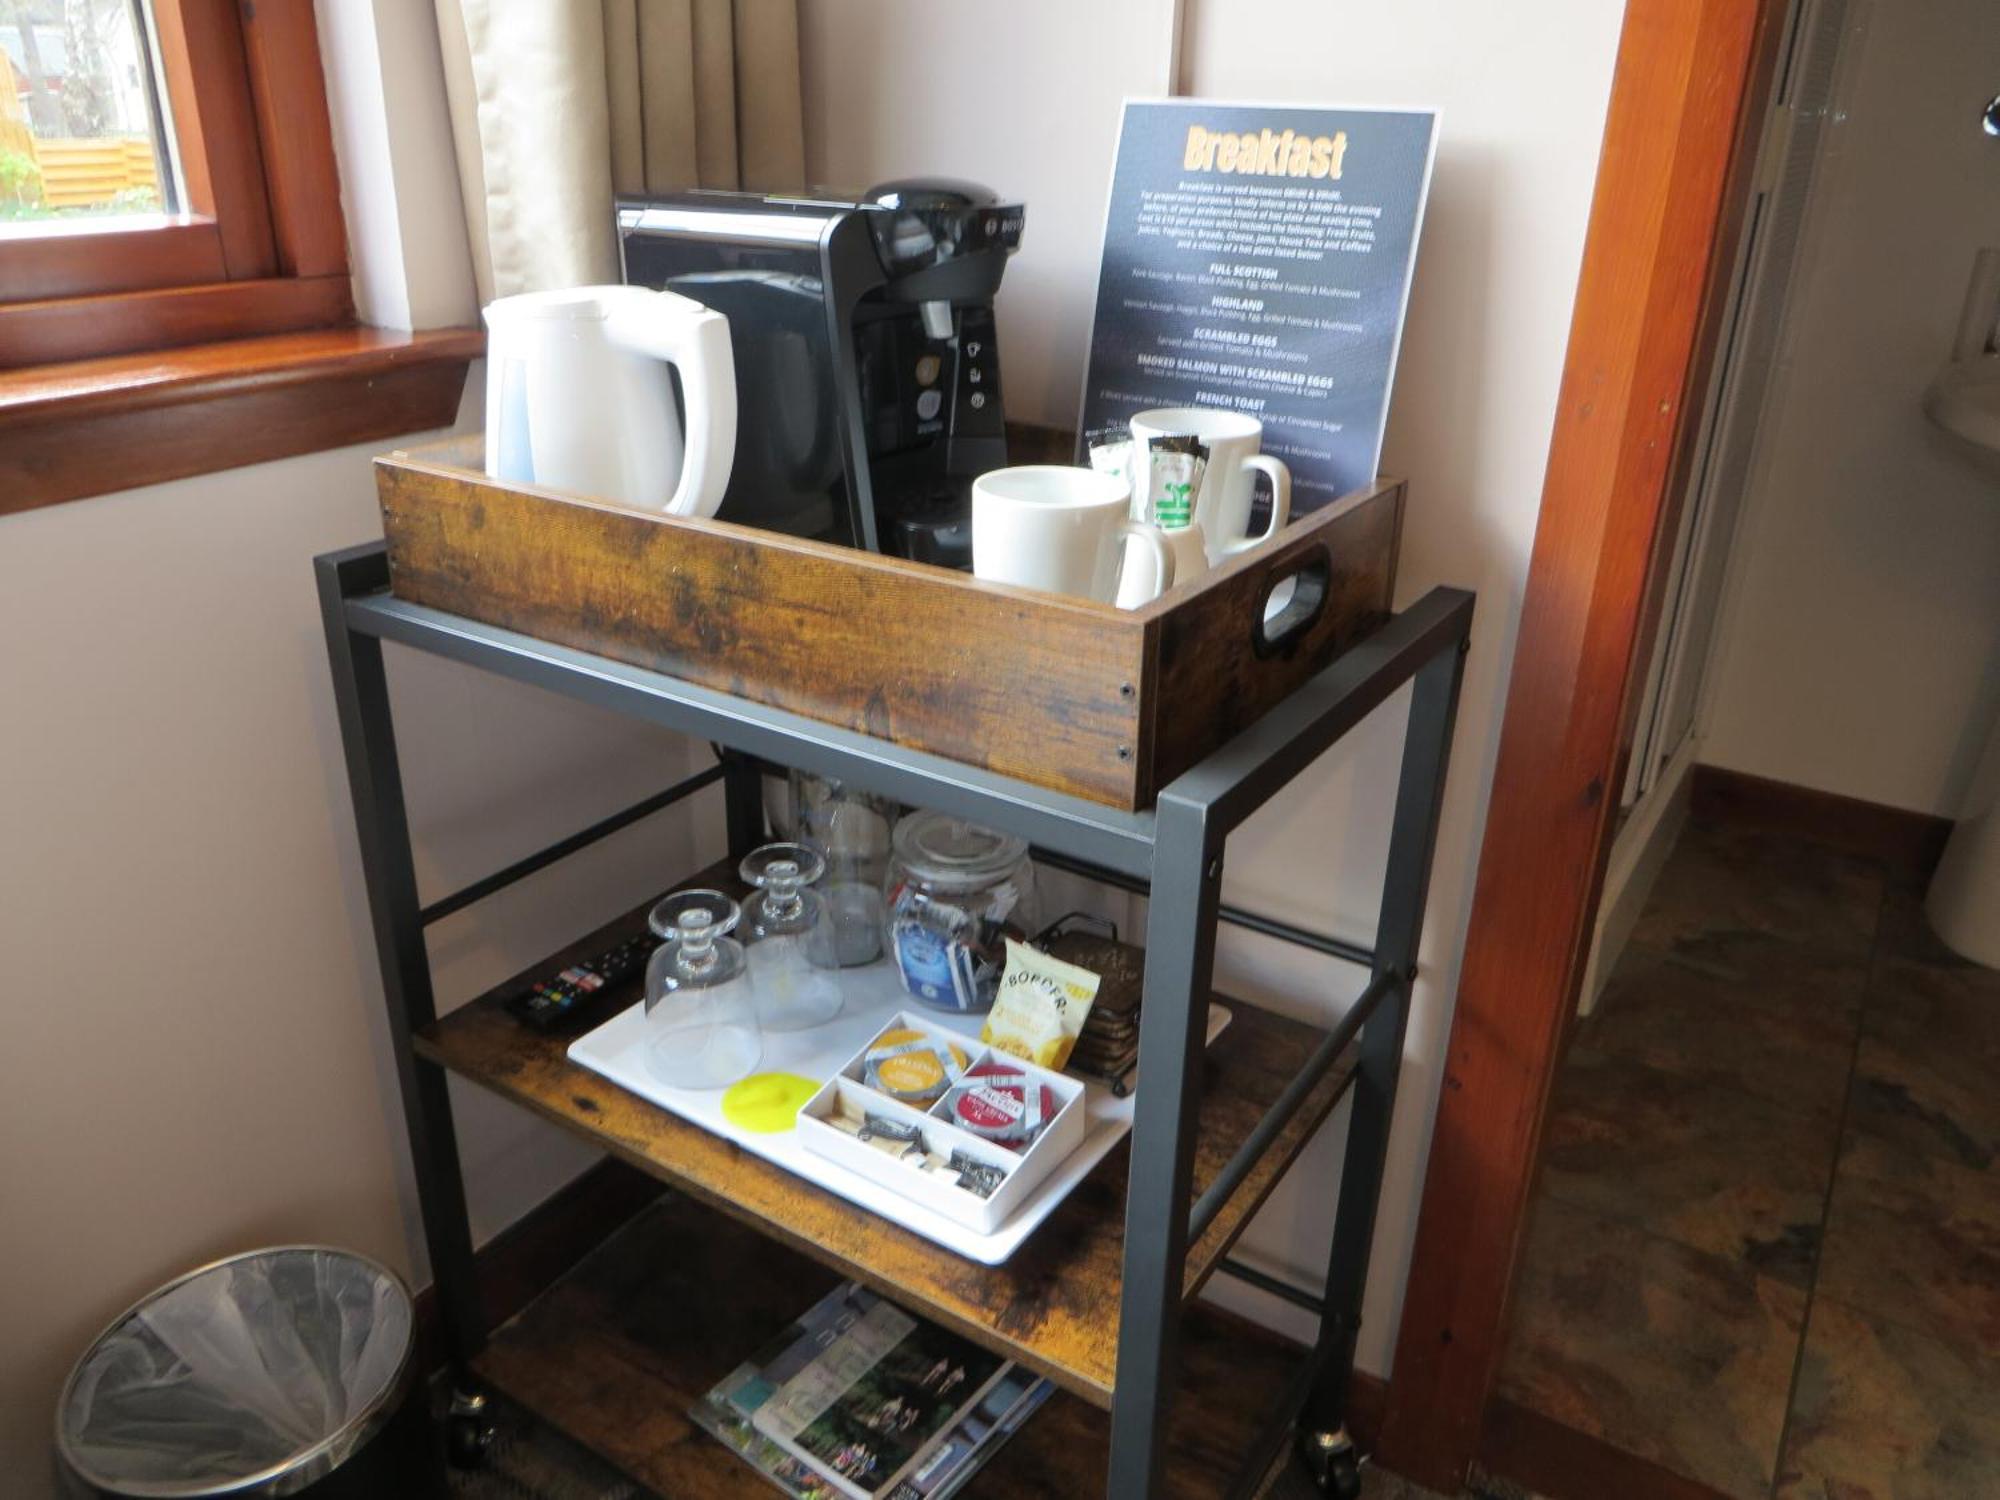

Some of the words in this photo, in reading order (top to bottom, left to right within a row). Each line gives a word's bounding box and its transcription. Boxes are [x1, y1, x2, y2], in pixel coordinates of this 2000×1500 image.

[1184, 125, 1347, 180] Breakfast
[1178, 205, 1196, 215] your
[1196, 206, 1232, 218] preferred
[1233, 208, 1257, 219] choice
[1267, 211, 1282, 221] hot
[1282, 212, 1303, 223] plate
[1304, 213, 1320, 224] and
[1320, 214, 1350, 226] seating
[1234, 197, 1258, 208] kindly
[1259, 199, 1285, 210] inform
[1297, 201, 1308, 211] by
[1333, 204, 1347, 214] the
[1348, 205, 1381, 216] evening
[1188, 217, 1214, 228] person
[1215, 219, 1238, 230] which
[1239, 220, 1270, 232] includes
[1272, 222, 1285, 233] the
[1326, 226, 1349, 237] Fresh
[1176, 238, 1191, 250] and
[1198, 240, 1222, 252] choice
[1238, 243, 1252, 254] hot
[1252, 244, 1273, 256] plate
[1274, 245, 1296, 257] listed
[1278, 234, 1303, 246] House
[1304, 235, 1323, 247] Teas
[1323, 237, 1340, 248] and
[1340, 238, 1372, 250] Coffees
[1209, 262, 1230, 276] FULL
[1232, 264, 1278, 279] SCOTTISH
[1211, 295, 1263, 311] HIGHLAND
[1192, 327, 1250, 345] SCRAMBLED
[1252, 333, 1278, 348] EGGS
[1136, 352, 1174, 368] SMOKED
[1176, 357, 1217, 374] SALMON
[1219, 362, 1246, 377] WITH
[1246, 366, 1305, 385] SCRAMBLED
[1306, 373, 1334, 388] EGGS
[1195, 391, 1232, 407] FRENCH
[1234, 396, 1265, 411] TOAST
